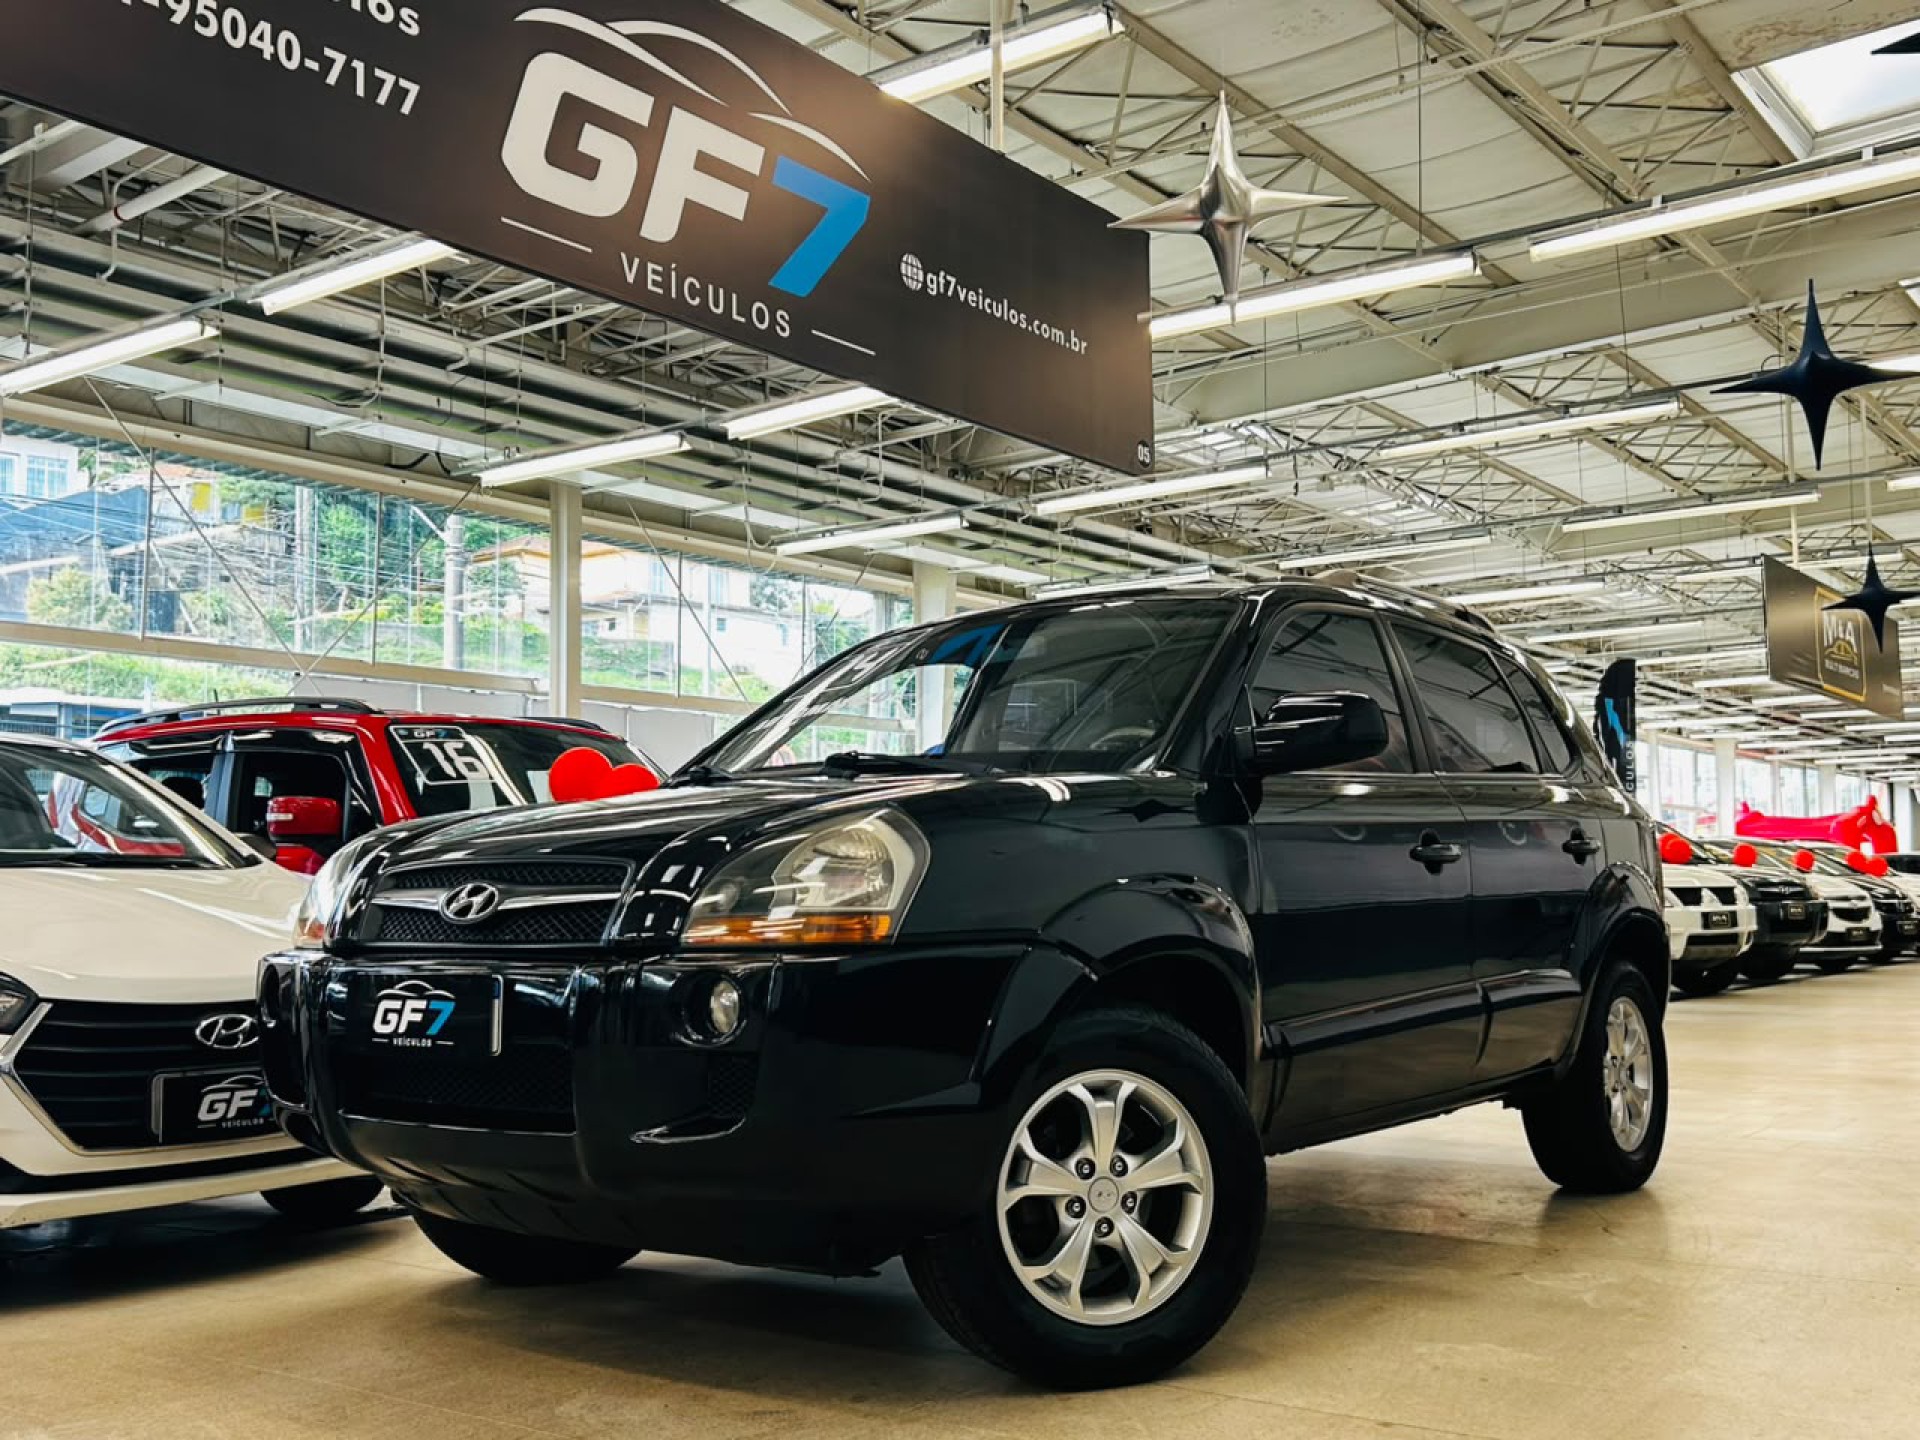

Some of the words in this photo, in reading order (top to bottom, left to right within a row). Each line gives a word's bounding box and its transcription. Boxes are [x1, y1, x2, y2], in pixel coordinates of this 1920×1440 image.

[121, 0, 420, 115] -95040-7177
[501, 52, 871, 297] GF7
[620, 252, 791, 338] VEÍCULOS
[926, 269, 1088, 355] gf7veiculos.com.br
[1137, 443, 1150, 463] 05
[422, 741, 491, 779] 16
[373, 999, 457, 1036] GF7
